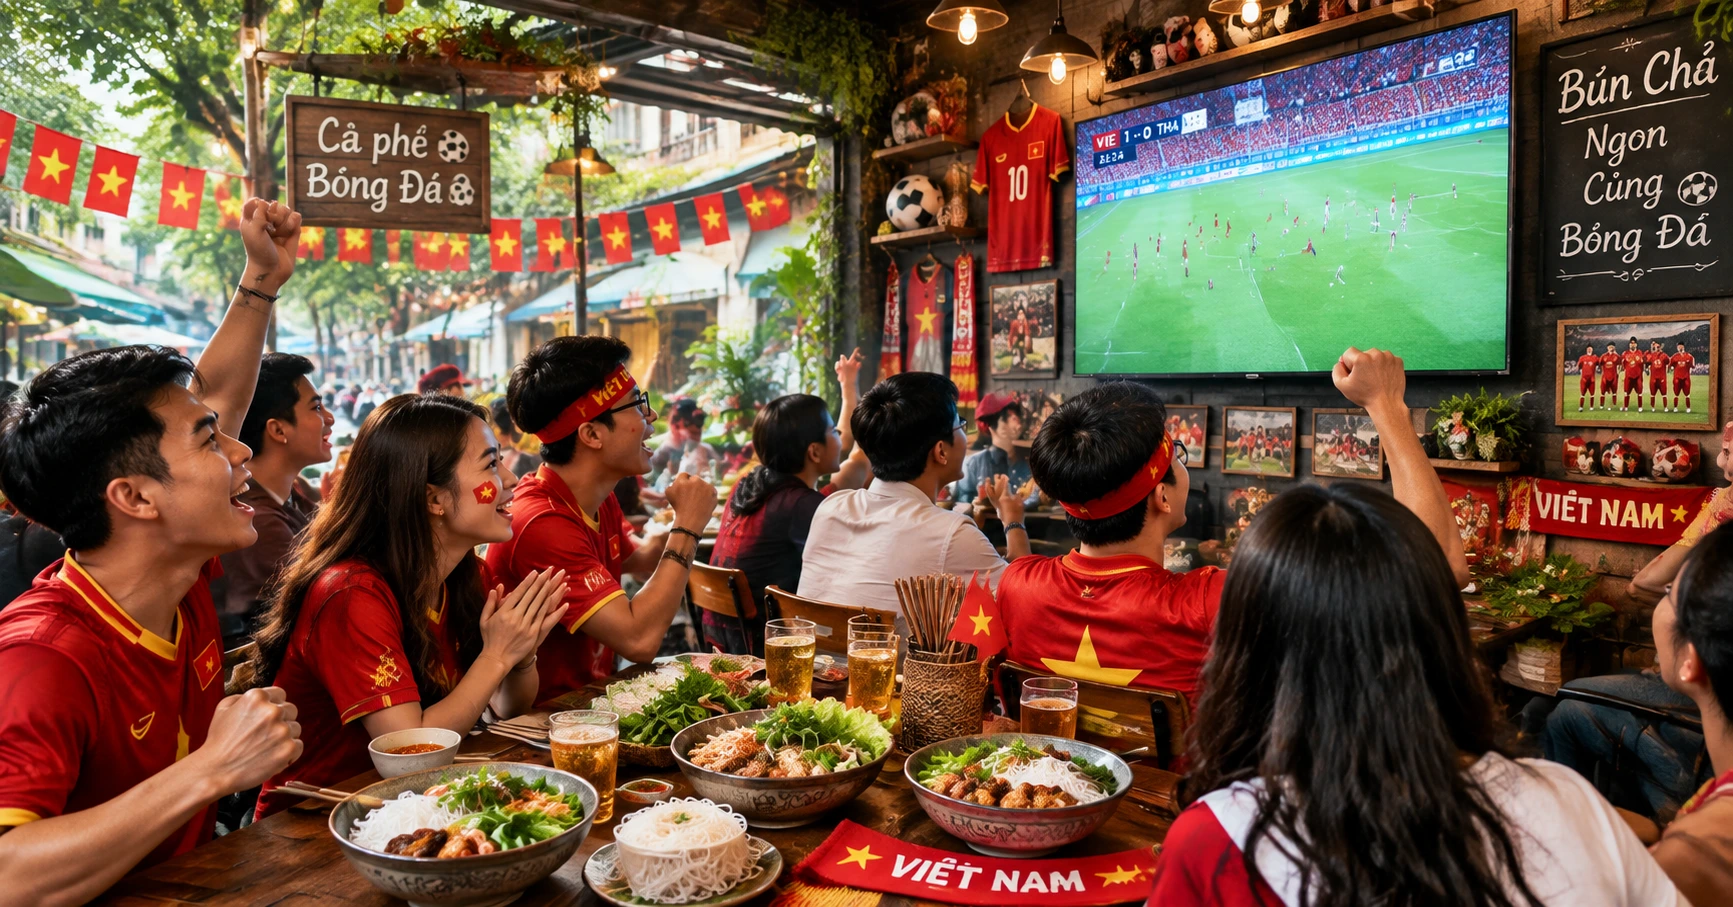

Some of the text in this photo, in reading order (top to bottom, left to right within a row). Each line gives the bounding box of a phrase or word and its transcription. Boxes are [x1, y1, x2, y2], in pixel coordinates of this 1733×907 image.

[1096, 133, 1116, 149] VIE
[1124, 130, 1129, 143] 1
[1143, 126, 1152, 140] 0
[1584, 123, 1668, 167] Ngon
[399, 169, 443, 204] Đá
[1008, 165, 1028, 202] 10
[1600, 498, 1664, 529] NAM
[991, 869, 1086, 893] NAM
